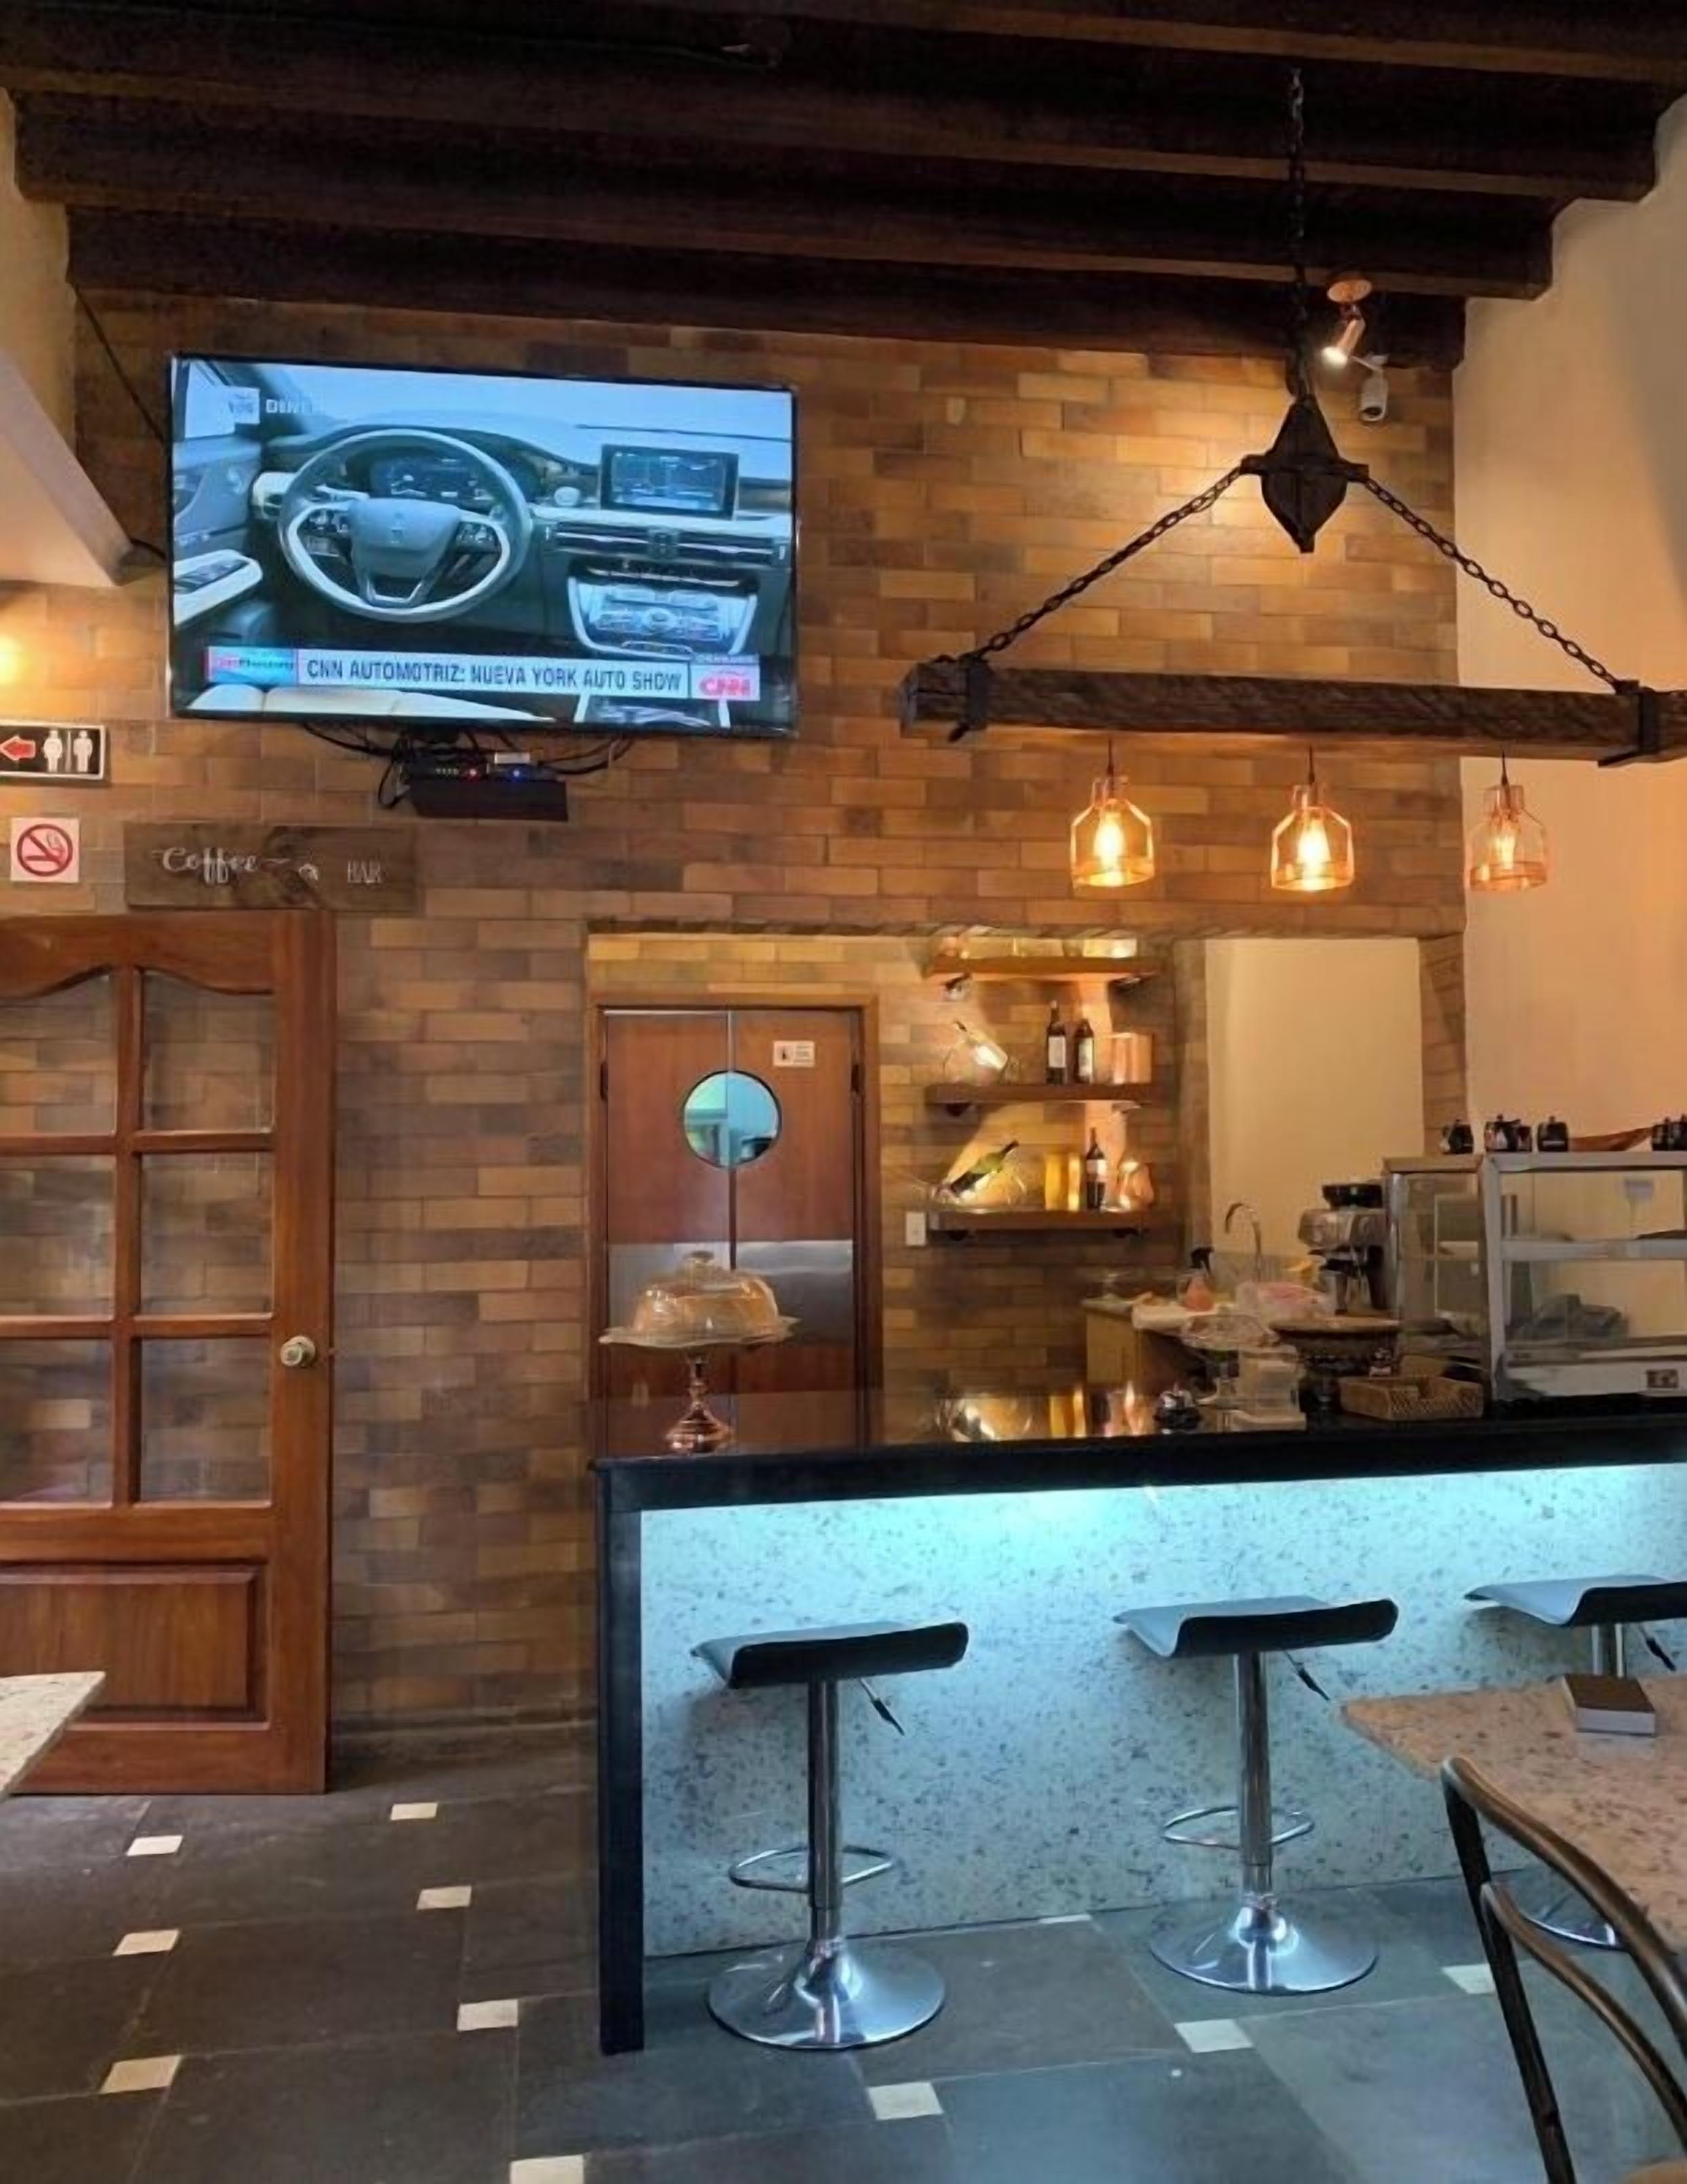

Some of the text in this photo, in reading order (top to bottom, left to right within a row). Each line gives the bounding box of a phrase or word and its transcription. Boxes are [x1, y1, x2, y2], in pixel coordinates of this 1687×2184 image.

[307, 659, 343, 679] CNN
[350, 660, 465, 682] AUTOMOTRIZ:
[472, 665, 526, 685] NUEVA
[533, 667, 578, 687] YORK
[583, 670, 626, 689] AUTO
[632, 671, 682, 691] SHOW
[162, 847, 259, 884] Coffee
